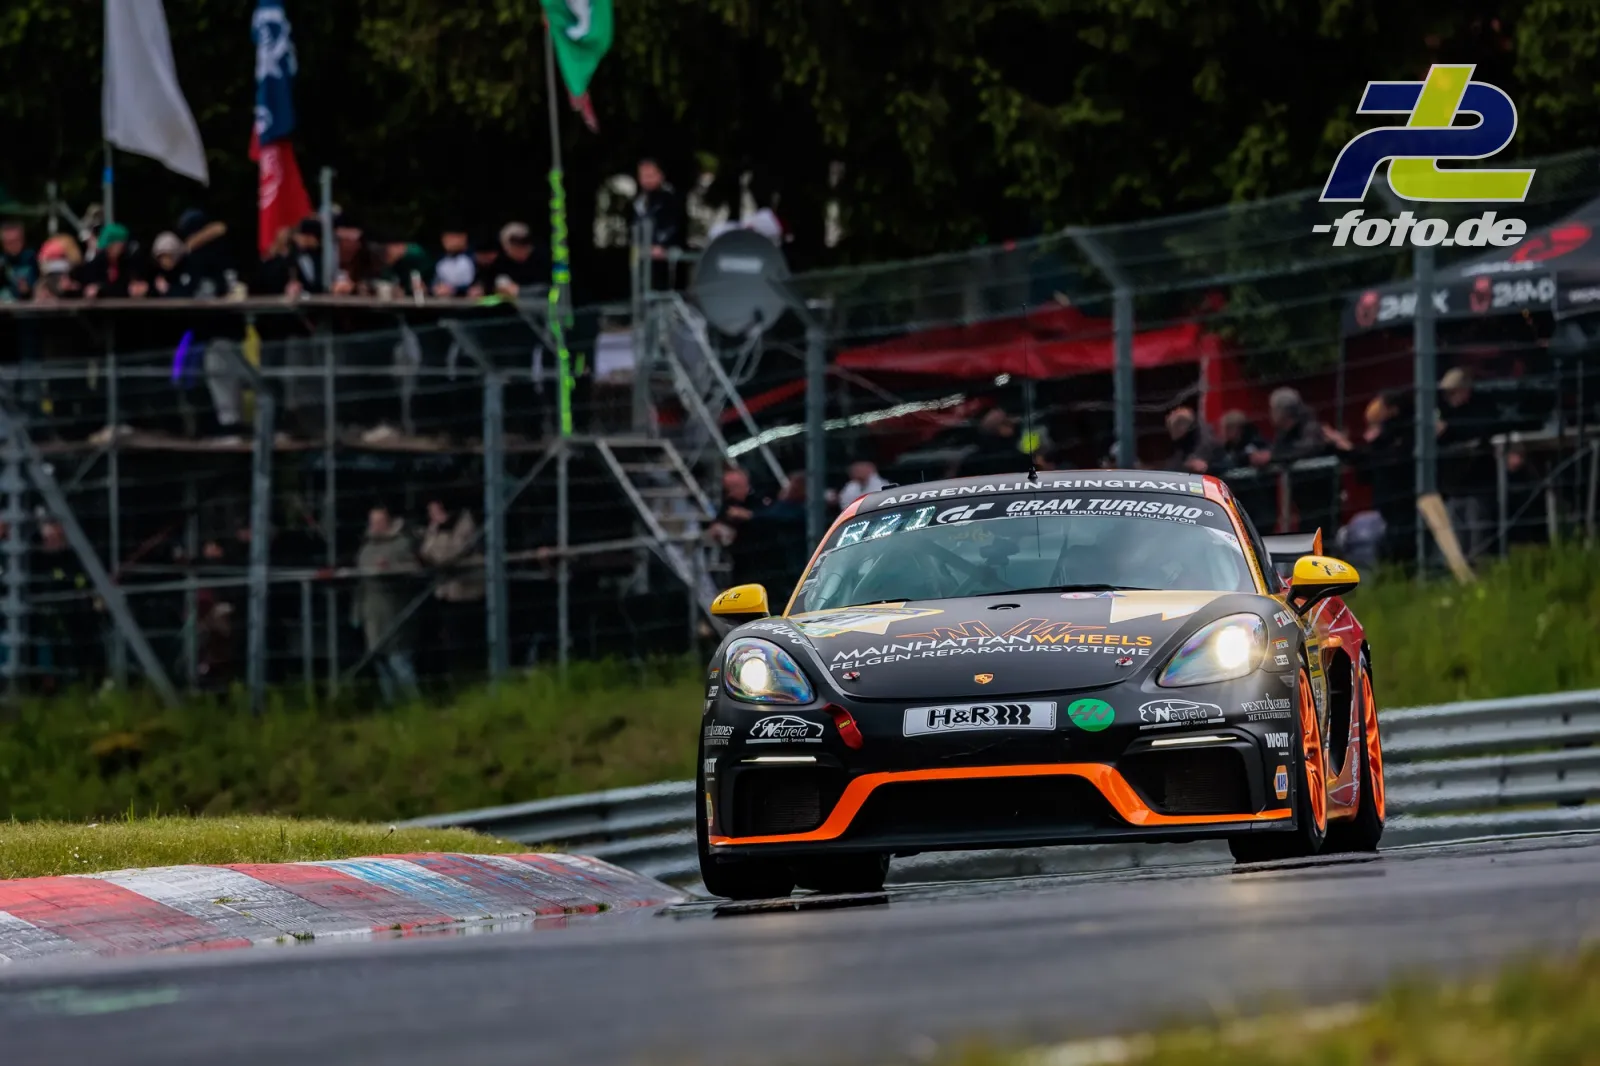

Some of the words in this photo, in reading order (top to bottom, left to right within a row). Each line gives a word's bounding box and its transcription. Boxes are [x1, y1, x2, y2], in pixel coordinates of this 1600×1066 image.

[878, 479, 1186, 507] ADRENALIN-RINGTAXI
[1006, 498, 1081, 512] GRAN
[1124, 511, 1197, 525] SIMULATOR
[829, 645, 1151, 671] FELGEN-REPARATURSYSTEME
[1155, 706, 1208, 722] Neufeld
[759, 722, 809, 738] Neufeld
